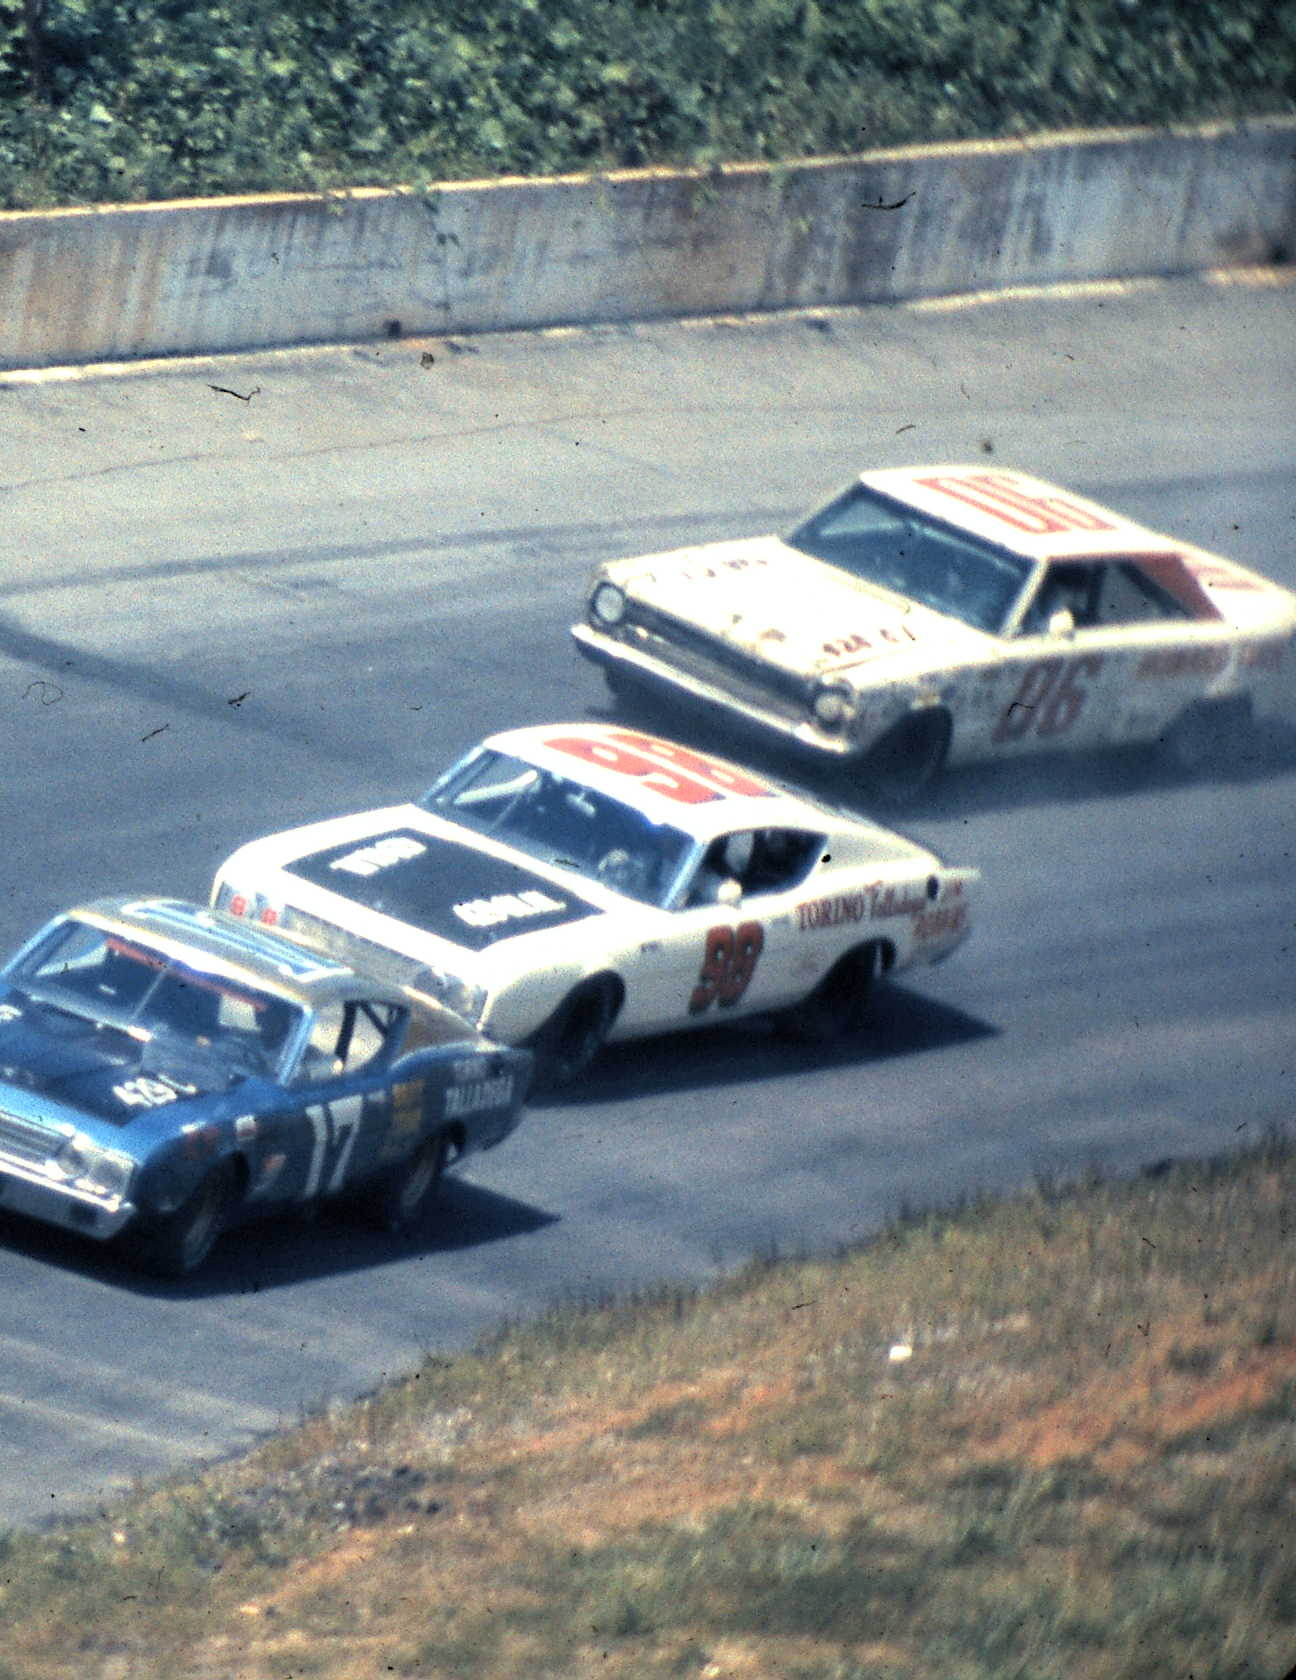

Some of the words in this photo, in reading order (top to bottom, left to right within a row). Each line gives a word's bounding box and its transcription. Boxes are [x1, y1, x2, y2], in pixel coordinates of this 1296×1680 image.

[544, 733, 784, 804] 98
[796, 893, 864, 931] TORINO
[688, 920, 766, 1016] 98
[304, 1094, 364, 1199] 17
